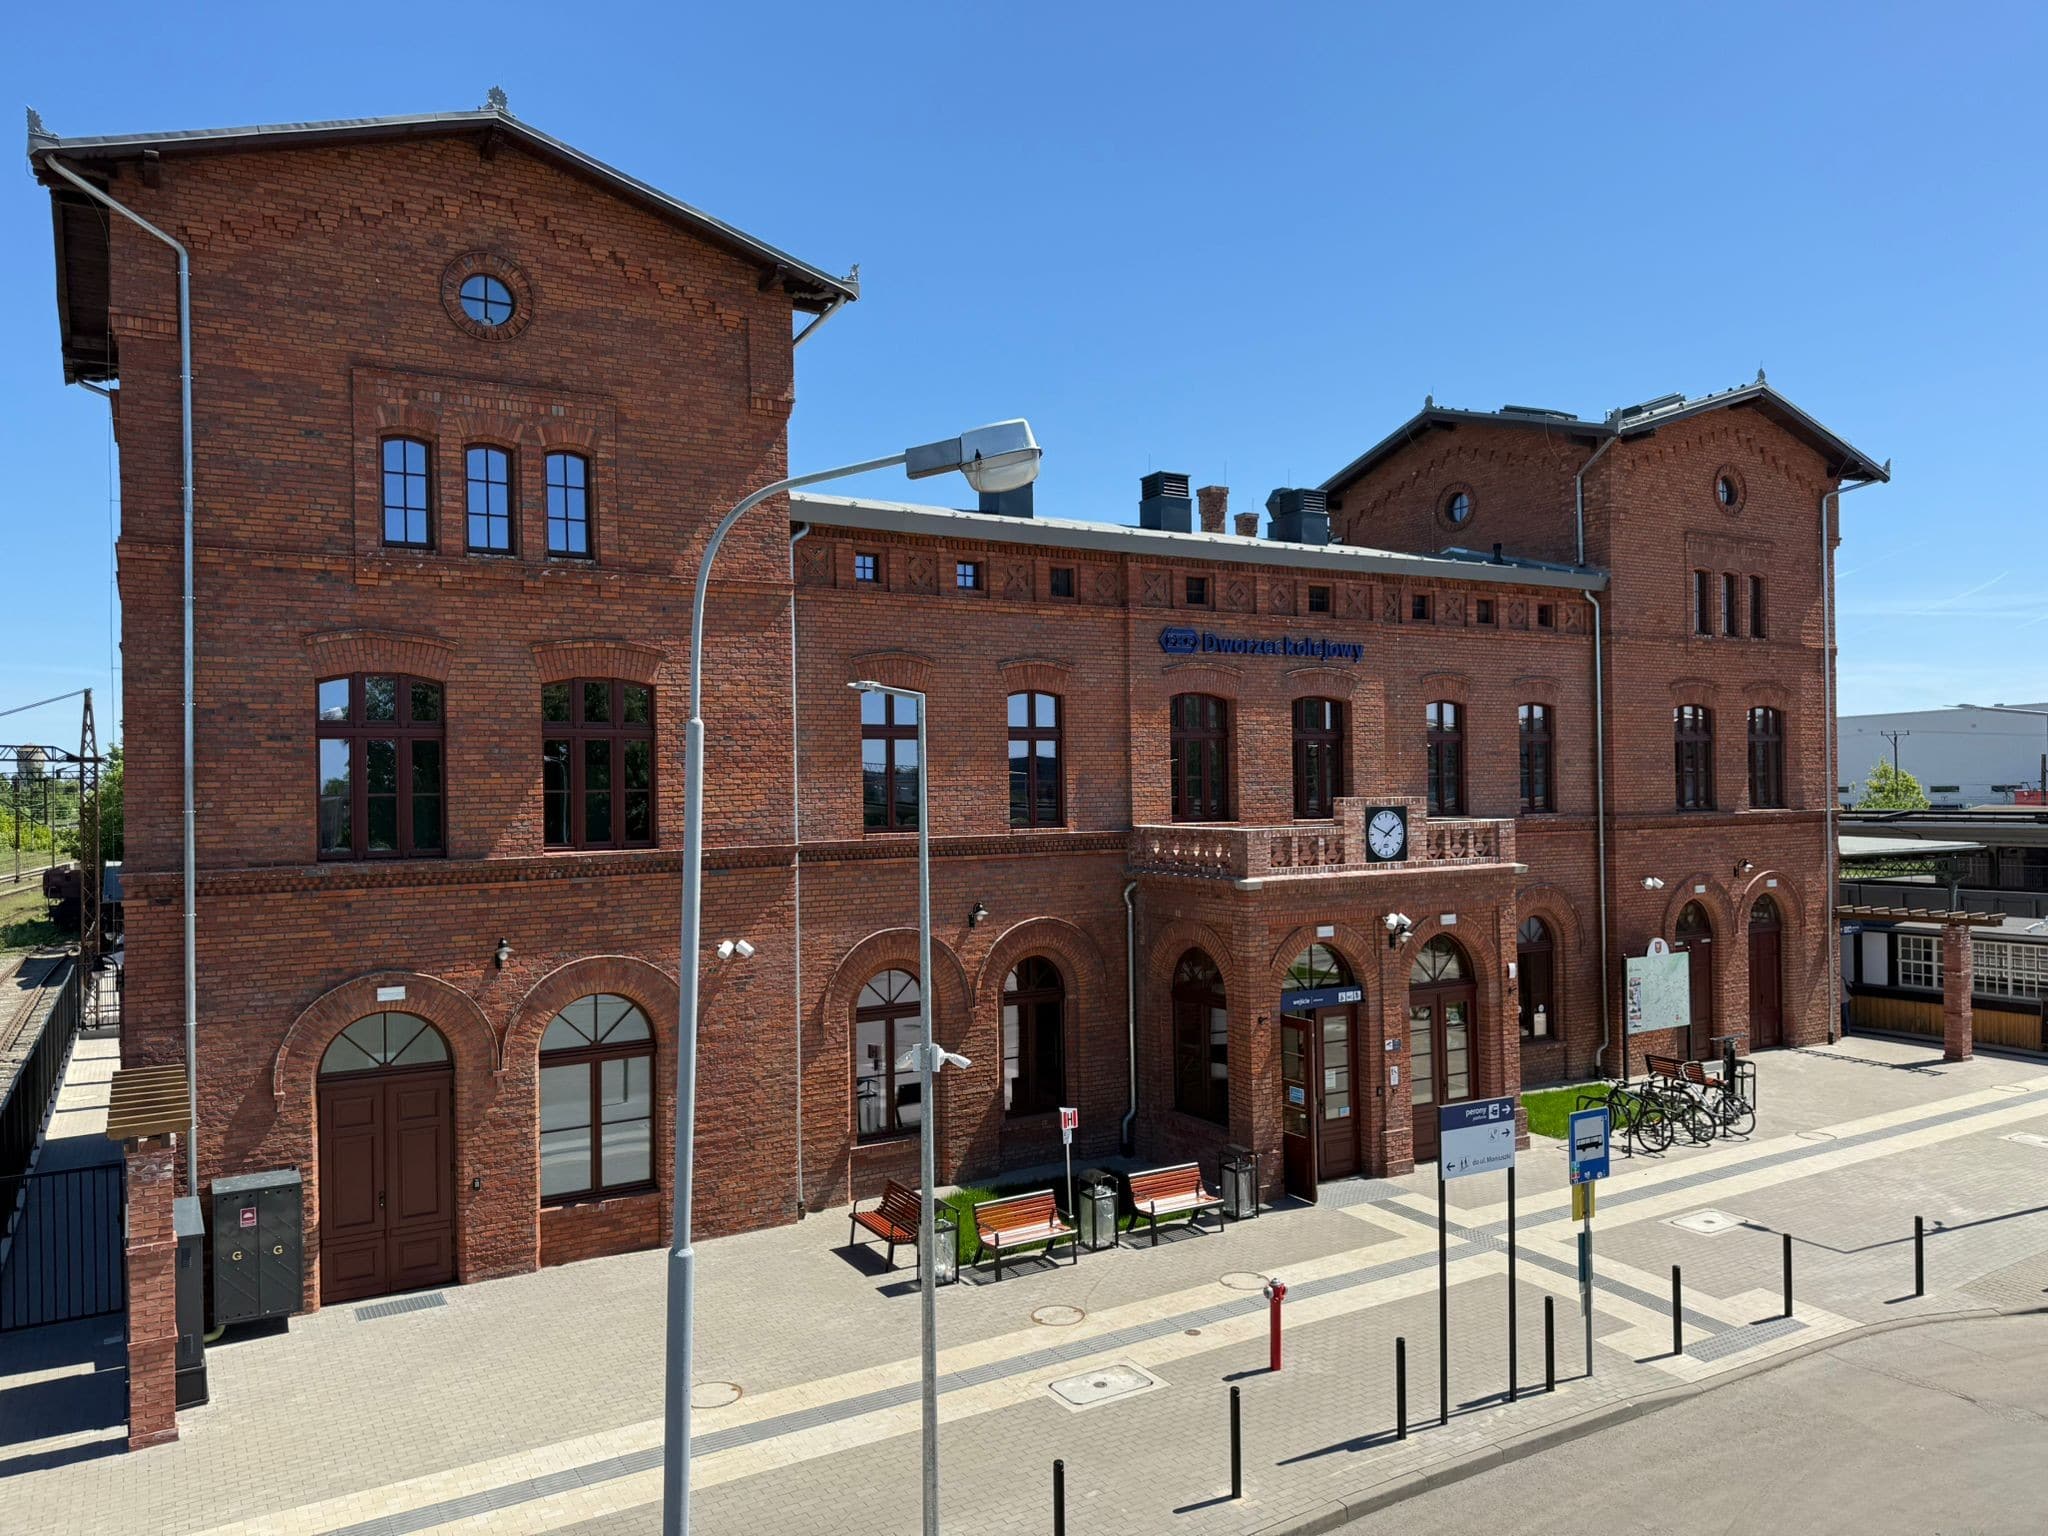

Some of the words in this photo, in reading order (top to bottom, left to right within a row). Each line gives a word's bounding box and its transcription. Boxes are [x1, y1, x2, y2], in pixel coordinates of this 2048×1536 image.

[1202, 631, 1282, 656] Dworzec
[1283, 635, 1365, 663] kolejowy
[1465, 1107, 1487, 1118] perony
